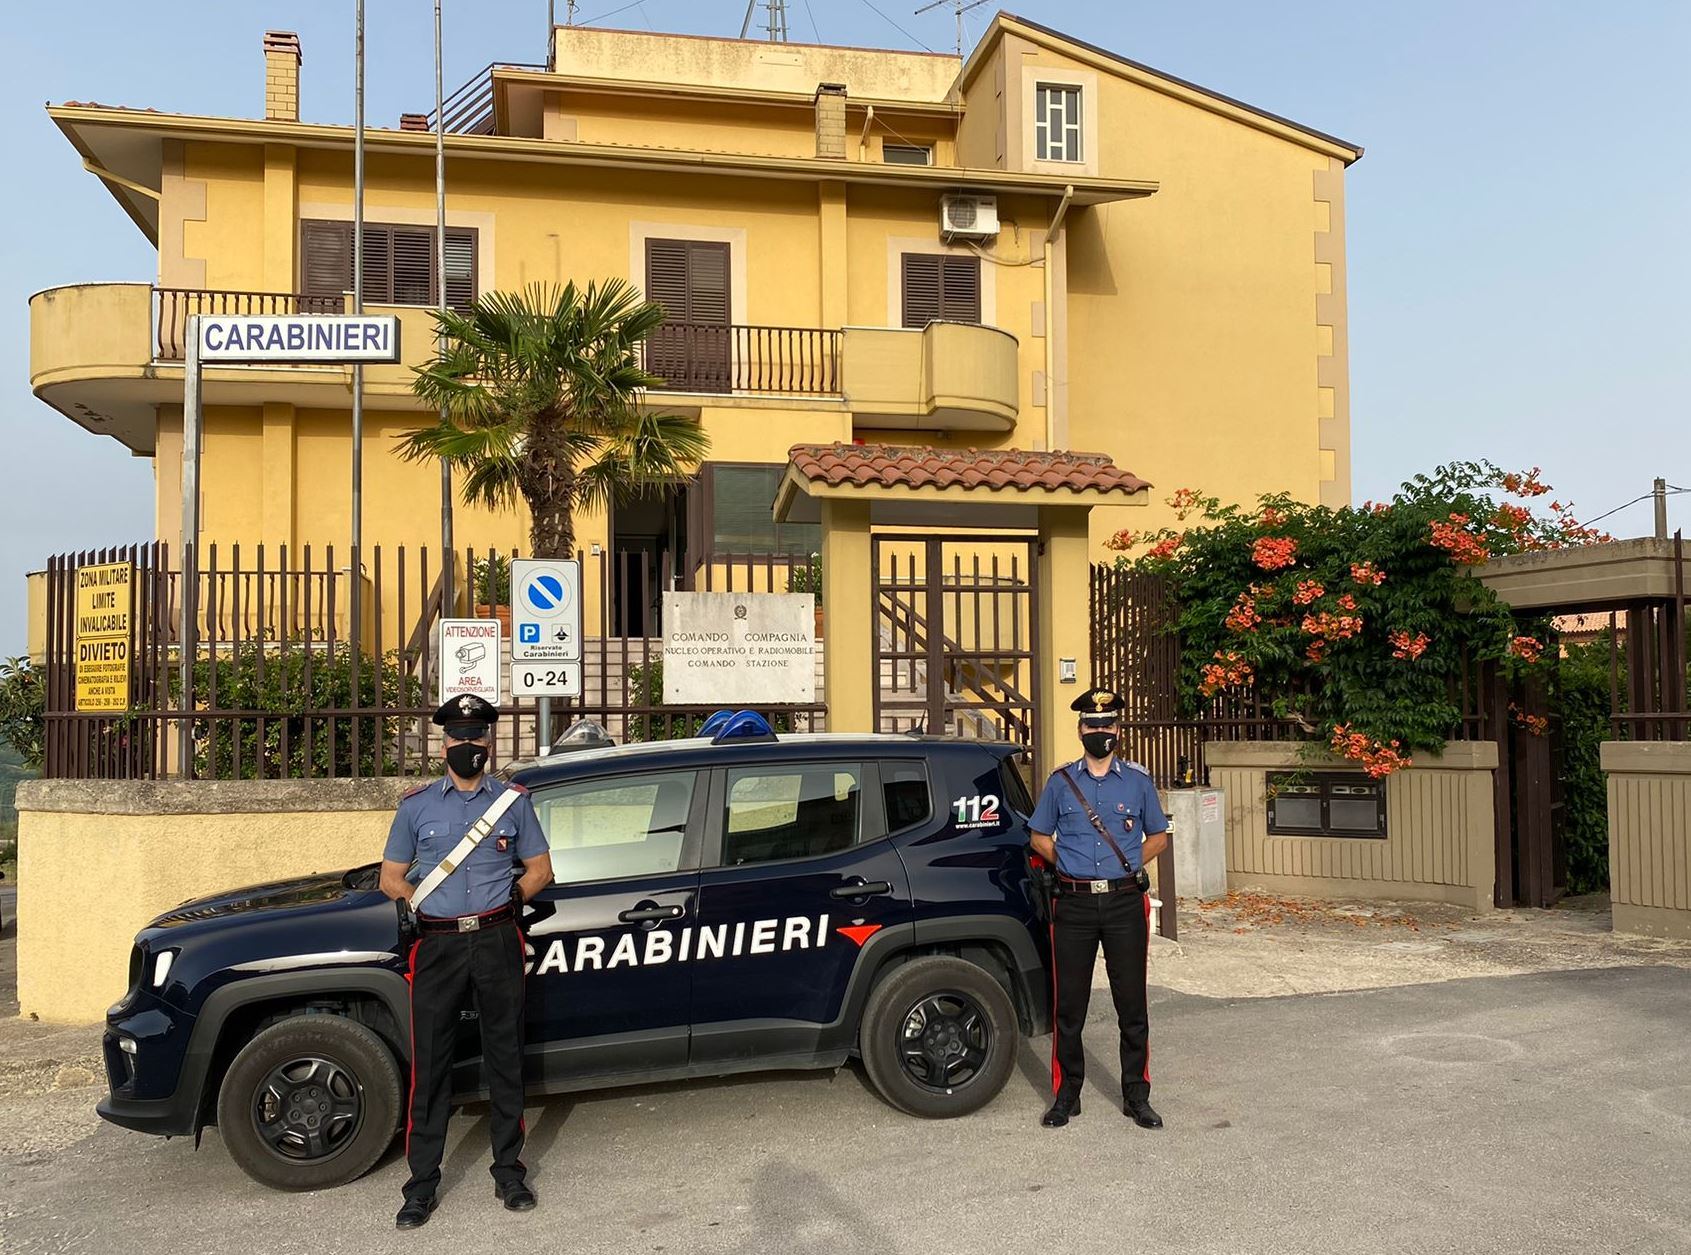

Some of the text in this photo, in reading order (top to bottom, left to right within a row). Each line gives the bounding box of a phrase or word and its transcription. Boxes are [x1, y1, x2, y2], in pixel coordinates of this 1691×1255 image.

[205, 323, 389, 351] CARABINIERI
[80, 567, 128, 588] ZONA MILITARE
[92, 592, 115, 609] LIMITE
[80, 614, 127, 633] INVALICABILE
[445, 626, 496, 638] ATTENZIONE
[523, 626, 536, 641] P
[672, 632, 808, 642] COMANDO COMPAGNIA
[80, 641, 126, 661] DIVIETO
[665, 647, 814, 655] NUCLEO OPERATIVO E RADIOMOBILE
[687, 659, 789, 668] COMANDO STAZIONE
[458, 677, 482, 686] AREA
[953, 794, 1000, 823] 112
